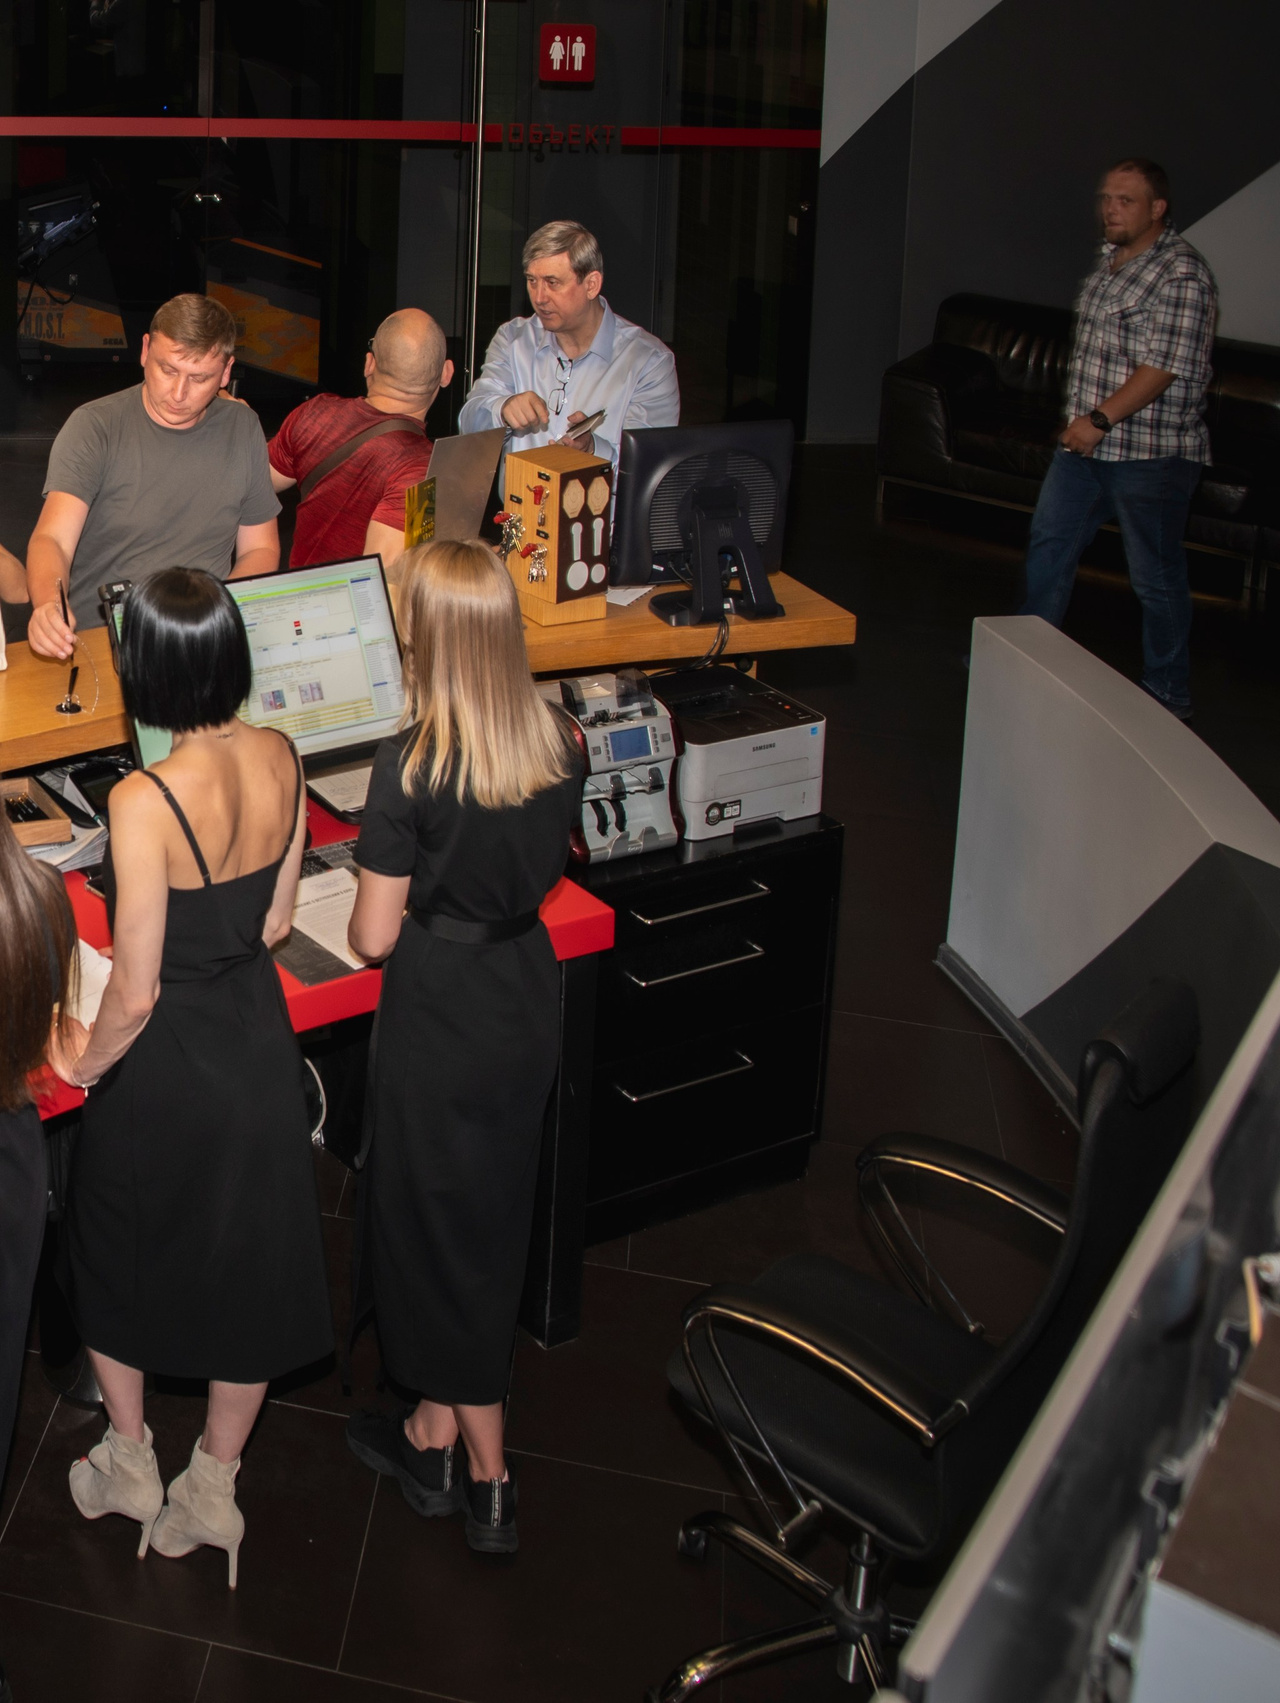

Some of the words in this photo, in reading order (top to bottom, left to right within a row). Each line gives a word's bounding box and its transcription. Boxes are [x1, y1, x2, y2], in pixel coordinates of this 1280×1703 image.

[508, 122, 616, 145] ОБЪЕКТ
[18, 312, 65, 340] .H.O.S.T.
[102, 338, 124, 346] SEGA
[752, 742, 776, 752] SAMSUNG
